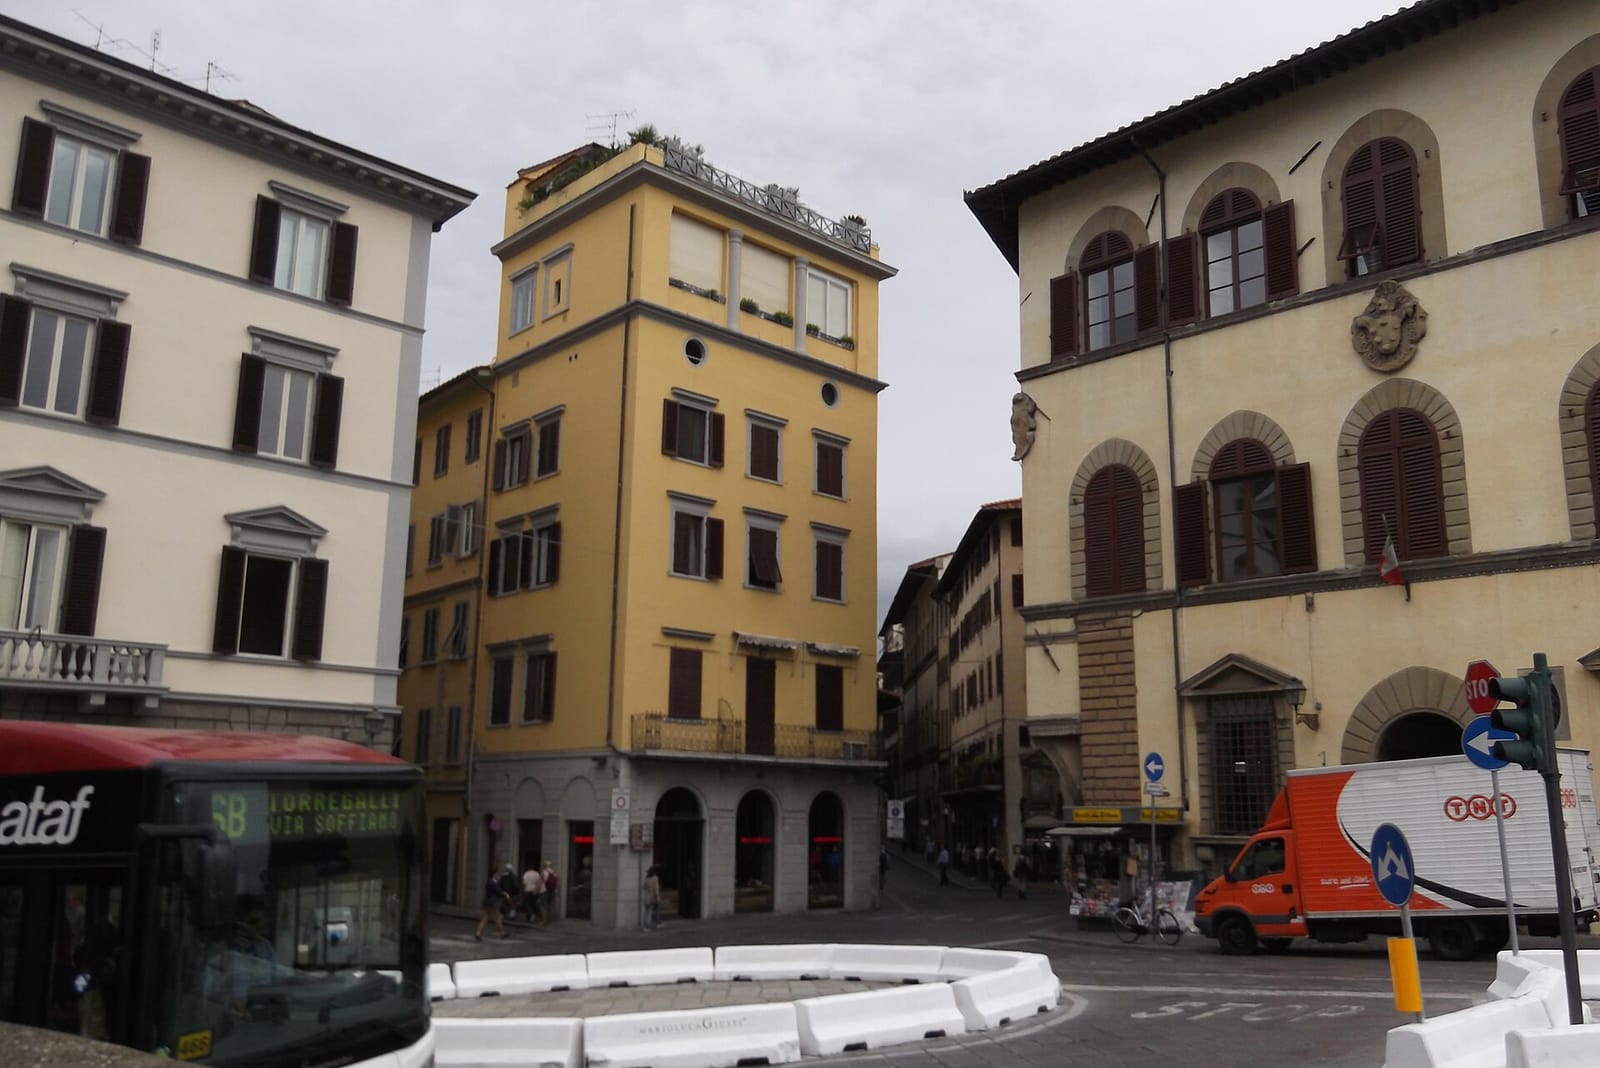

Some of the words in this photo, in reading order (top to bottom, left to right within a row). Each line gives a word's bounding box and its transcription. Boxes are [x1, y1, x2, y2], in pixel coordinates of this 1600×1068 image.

[1466, 678, 1489, 700] STO
[0, 785, 96, 845] ataf
[1446, 795, 1515, 819] TNT
[1130, 1001, 1366, 1023] STOP
